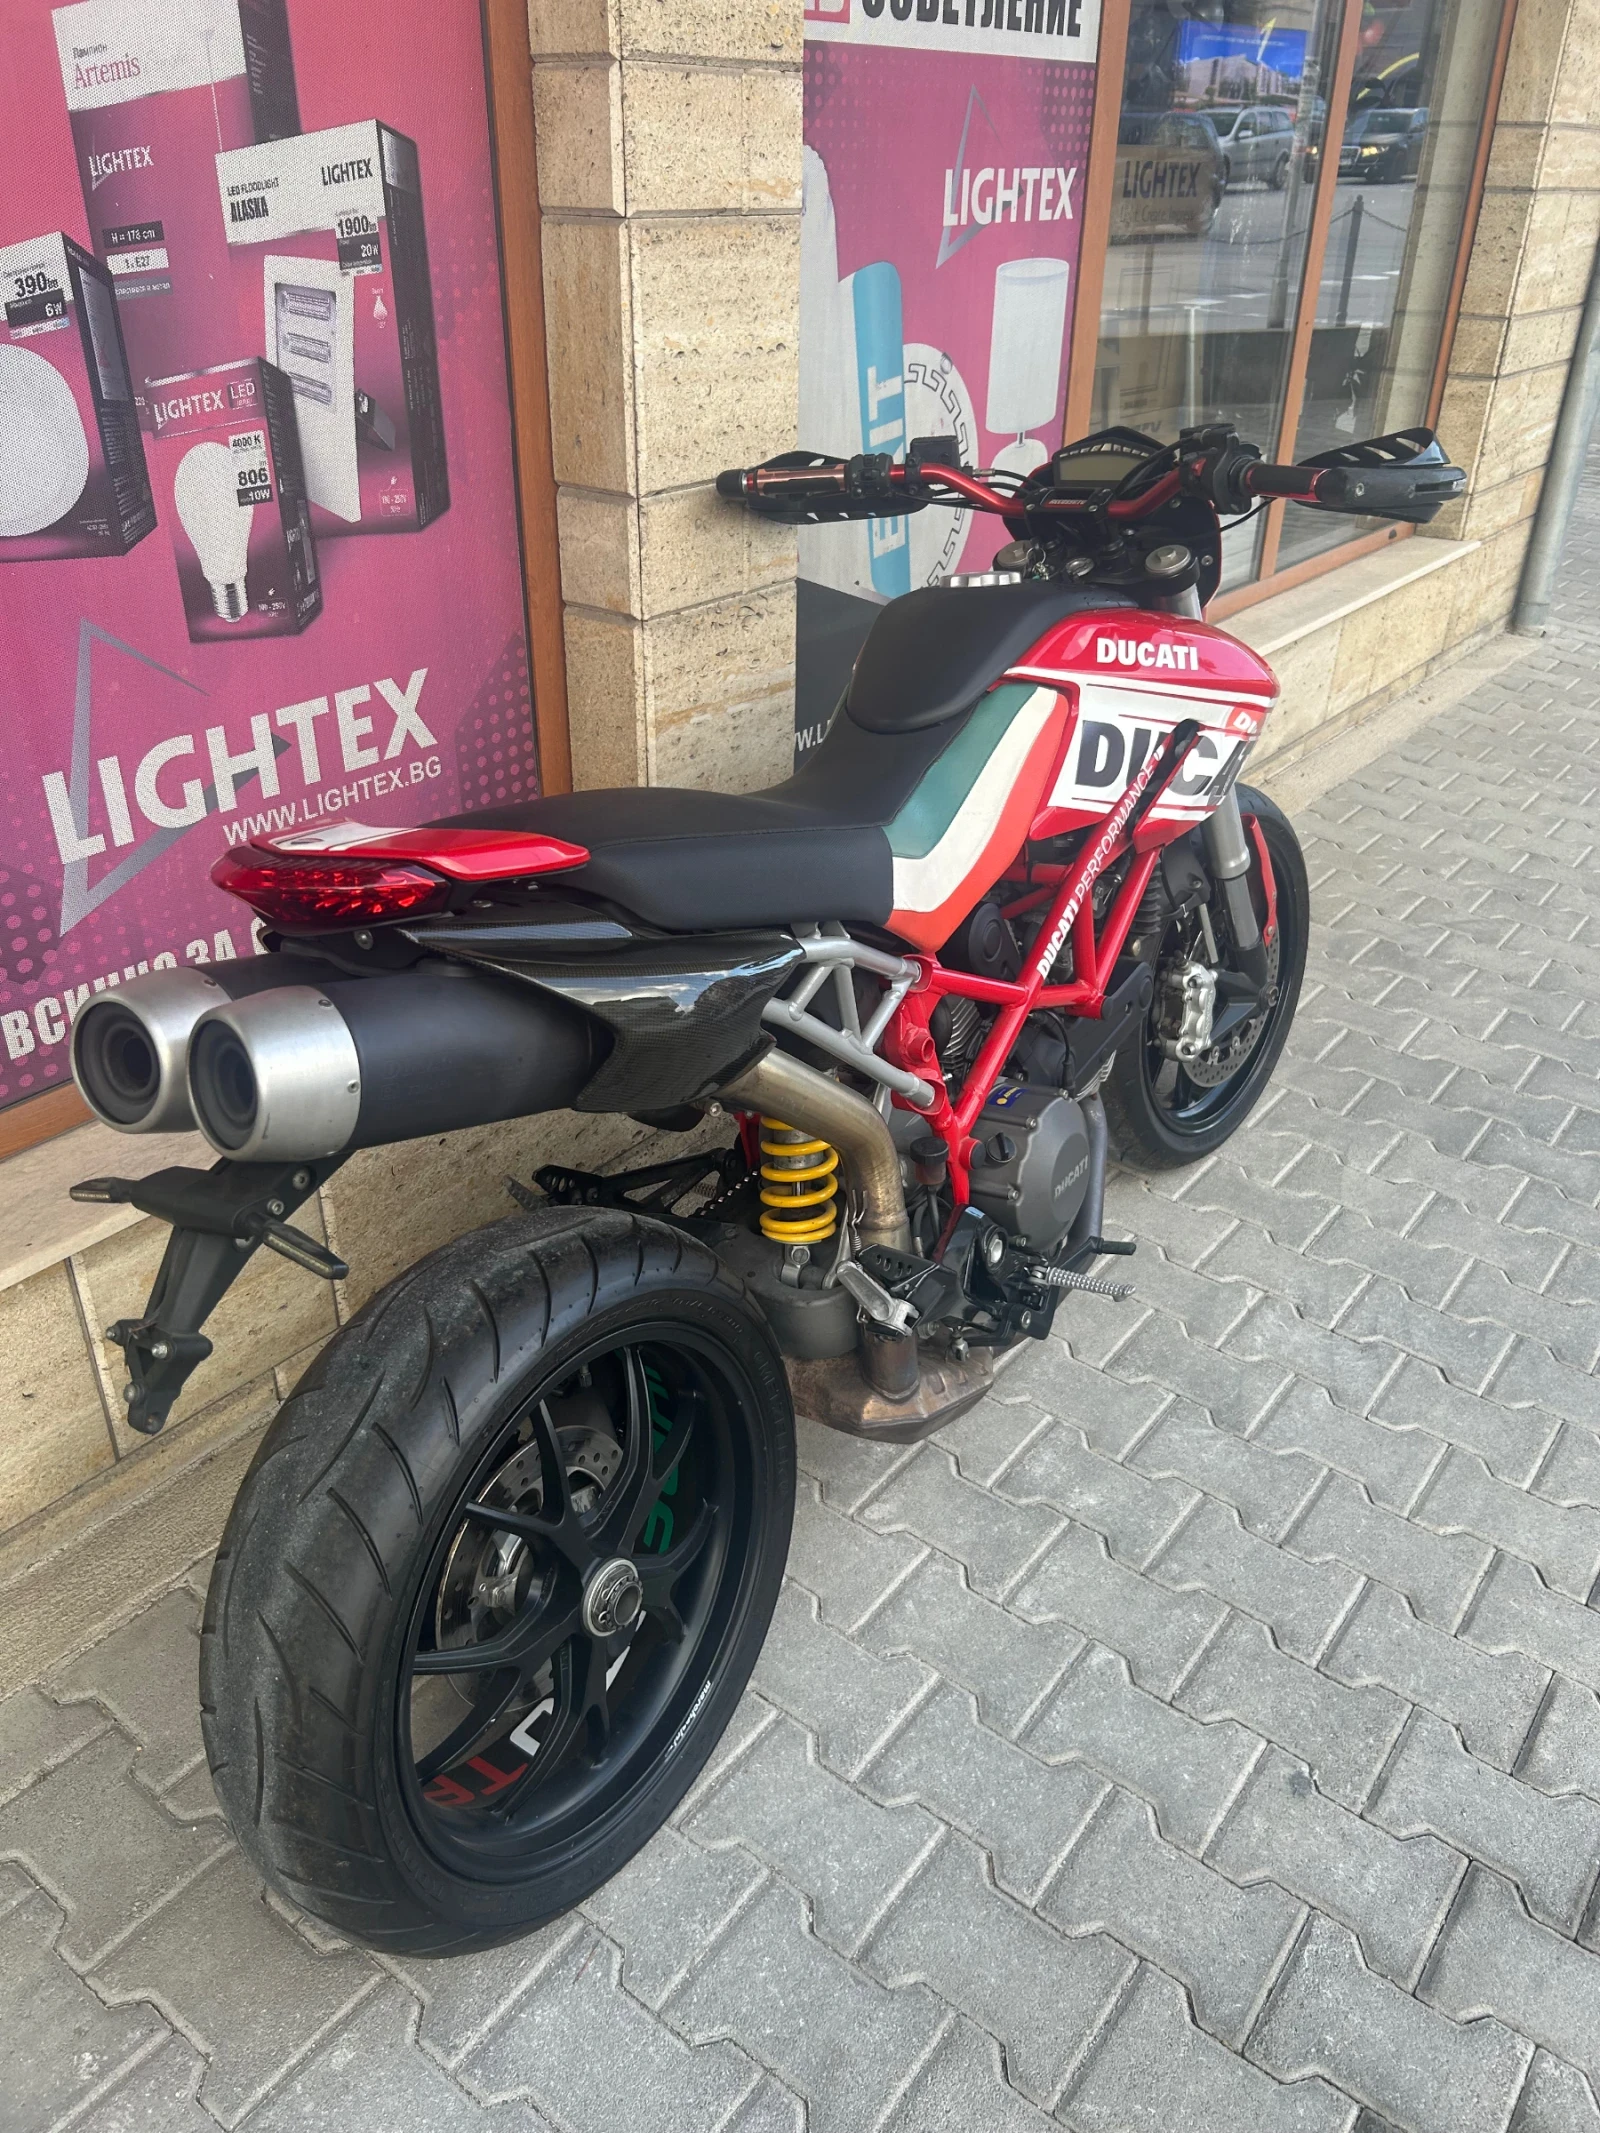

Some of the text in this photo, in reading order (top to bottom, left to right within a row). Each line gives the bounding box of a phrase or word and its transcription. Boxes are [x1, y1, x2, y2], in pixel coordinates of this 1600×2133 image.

[73, 52, 141, 90] Artemis
[89, 145, 154, 177] LIGHTEX
[321, 158, 373, 186] LIGHTEX
[227, 185, 240, 197] LED
[1122, 160, 1201, 198] LIGHTEX
[230, 196, 269, 222] ALASKA
[942, 167, 1077, 227] LIGHTEX
[111, 232, 119, 244] H
[153, 390, 225, 424] LIGHTEX
[230, 382, 256, 400] LED
[254, 434, 262, 446] K
[237, 467, 269, 487] 806
[249, 488, 271, 502] 10W
[1096, 637, 1199, 670] DUCATI
[42, 668, 438, 865] LIGHTEX
[223, 756, 443, 846] WWW.LIGHTEX.BG
[1036, 761, 1155, 980] DUCATI PERFORMANCE
[1053, 1155, 1089, 1199] DUCATI
